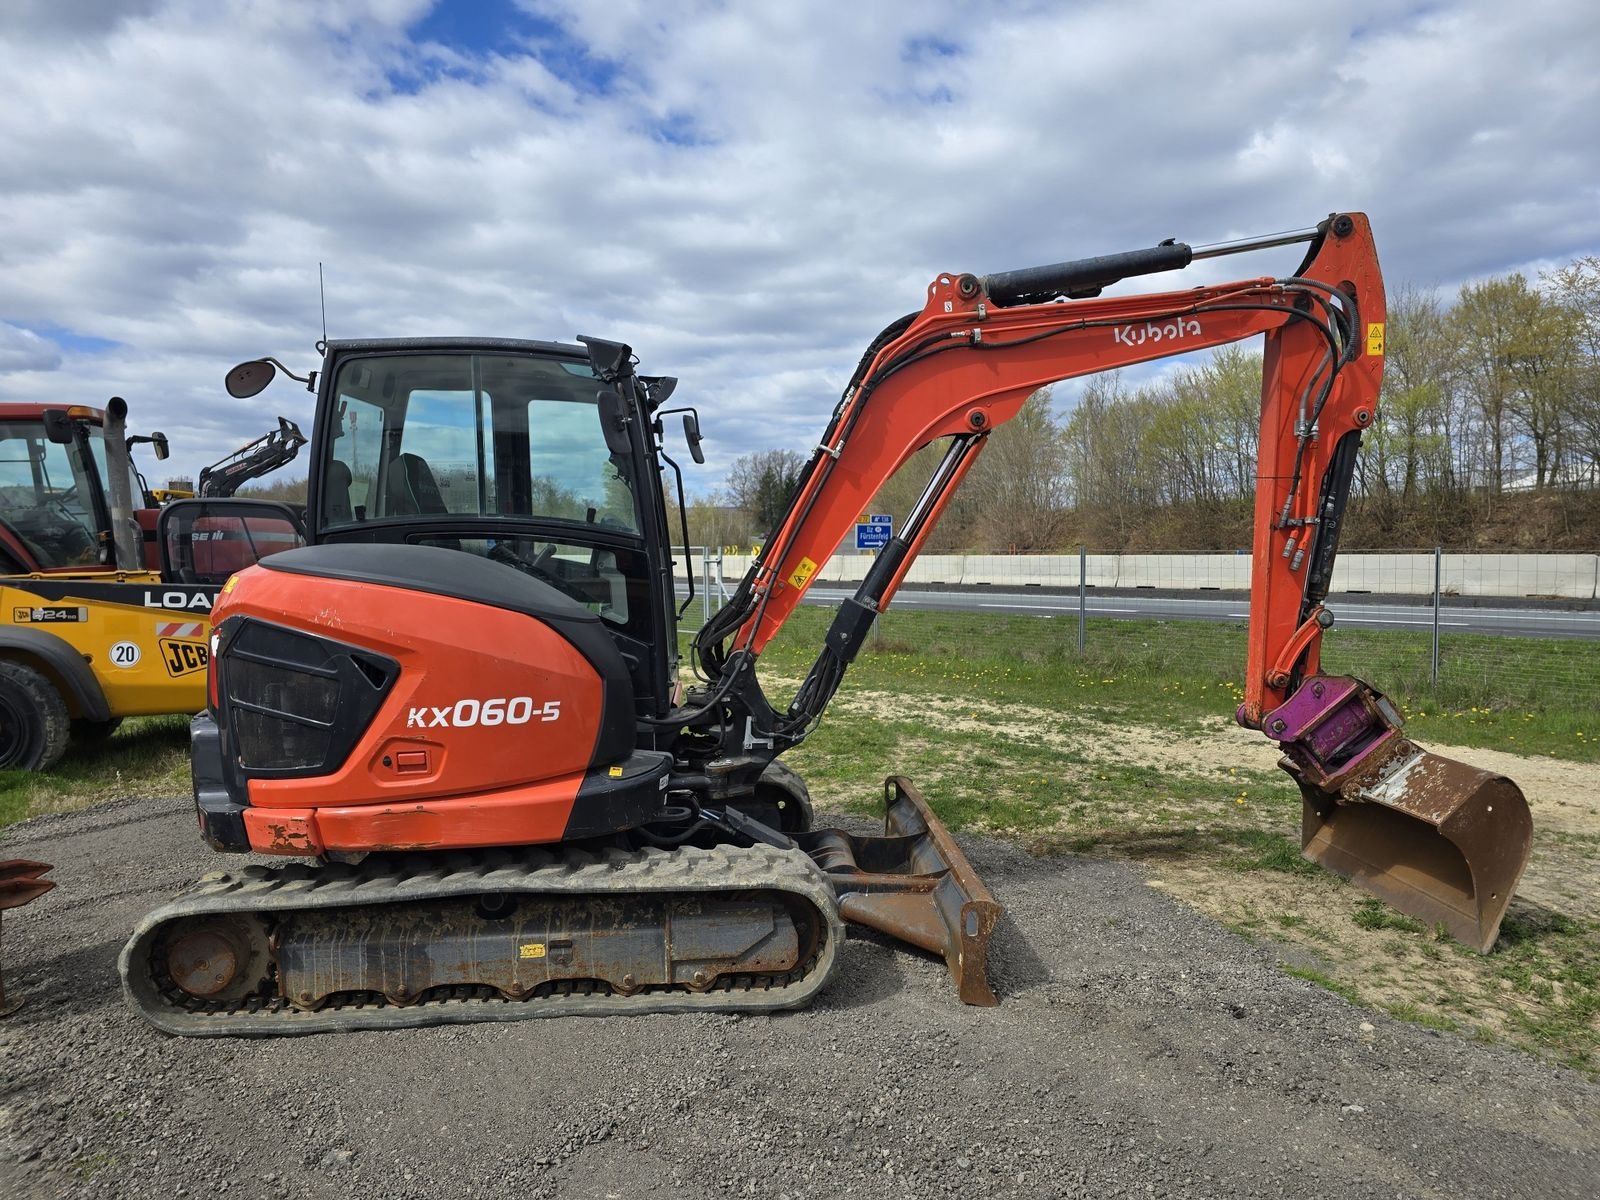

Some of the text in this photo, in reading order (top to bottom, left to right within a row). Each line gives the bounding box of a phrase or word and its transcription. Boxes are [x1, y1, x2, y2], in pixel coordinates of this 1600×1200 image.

[1114, 317, 1202, 346] Kubota
[144, 591, 220, 609] LOA
[116, 646, 135, 662] 20
[167, 642, 208, 673] JCB
[407, 696, 561, 728] KX060-5
